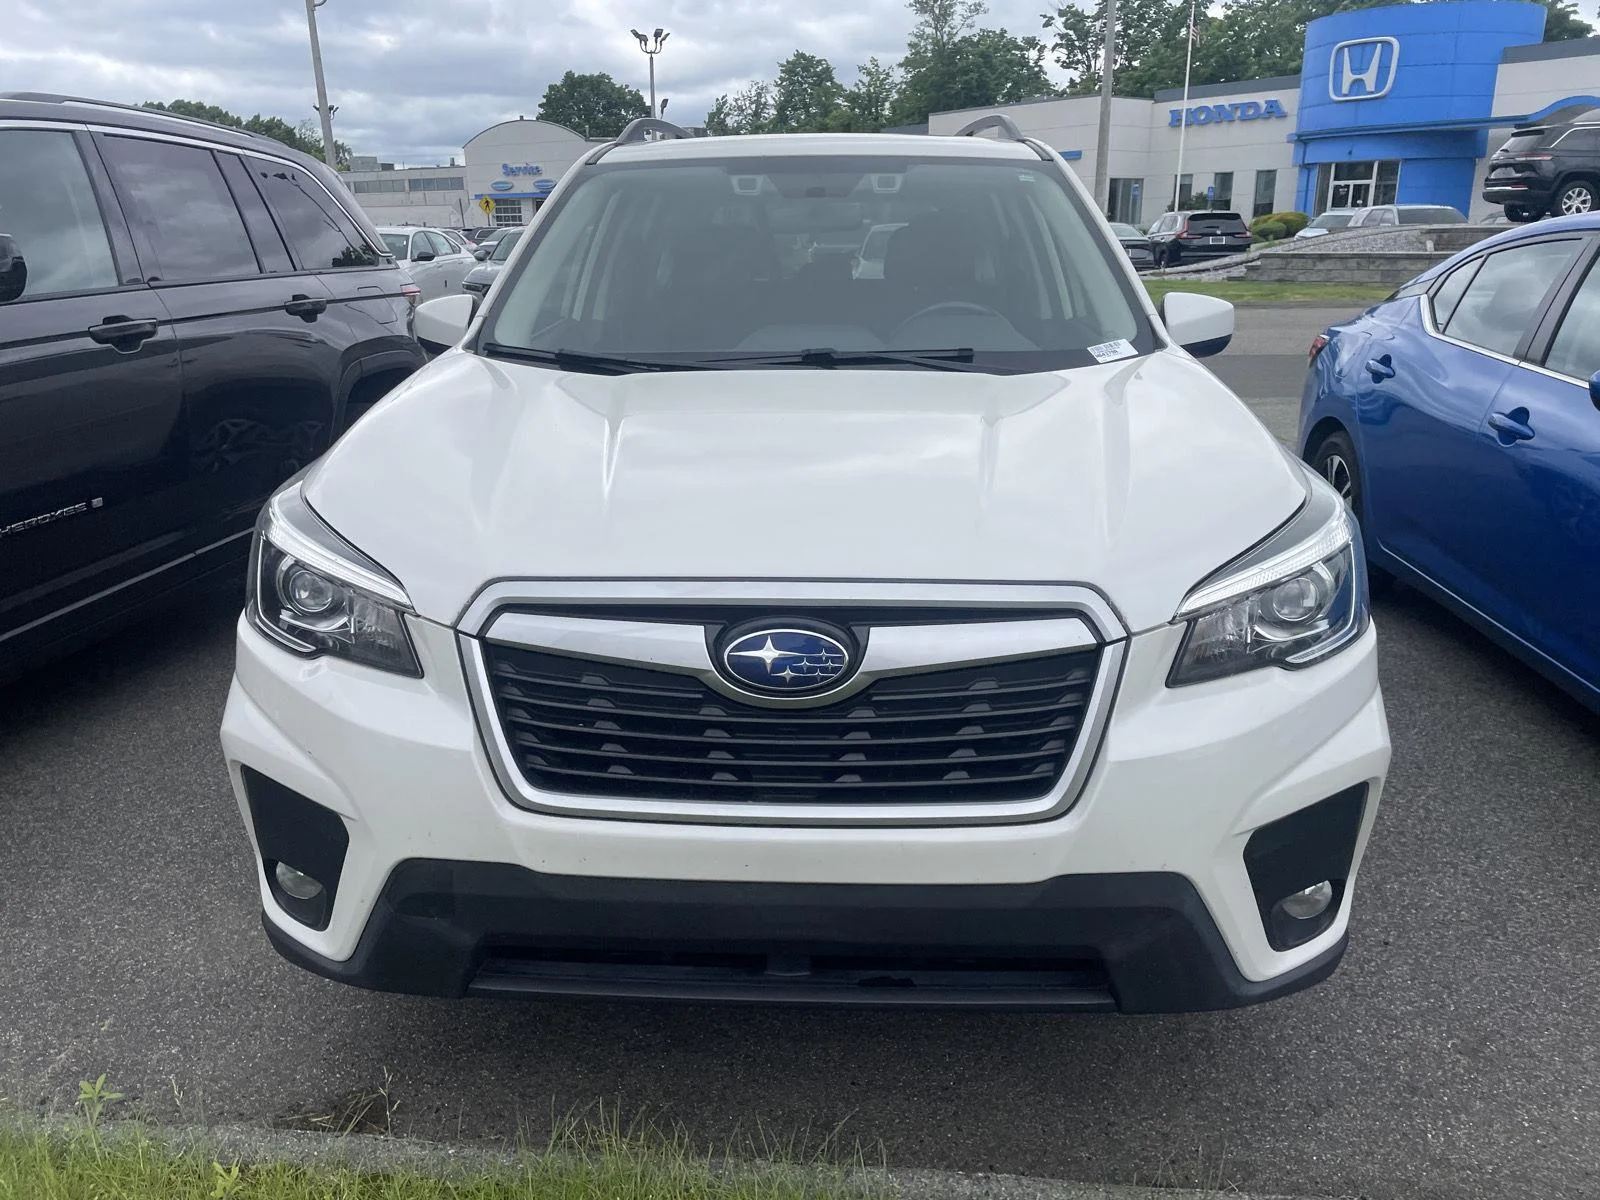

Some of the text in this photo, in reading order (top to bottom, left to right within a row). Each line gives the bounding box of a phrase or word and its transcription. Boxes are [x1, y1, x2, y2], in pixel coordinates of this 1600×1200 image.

[1342, 43, 1382, 95] H
[1168, 99, 1287, 128] HONDA
[502, 163, 543, 177] Service
